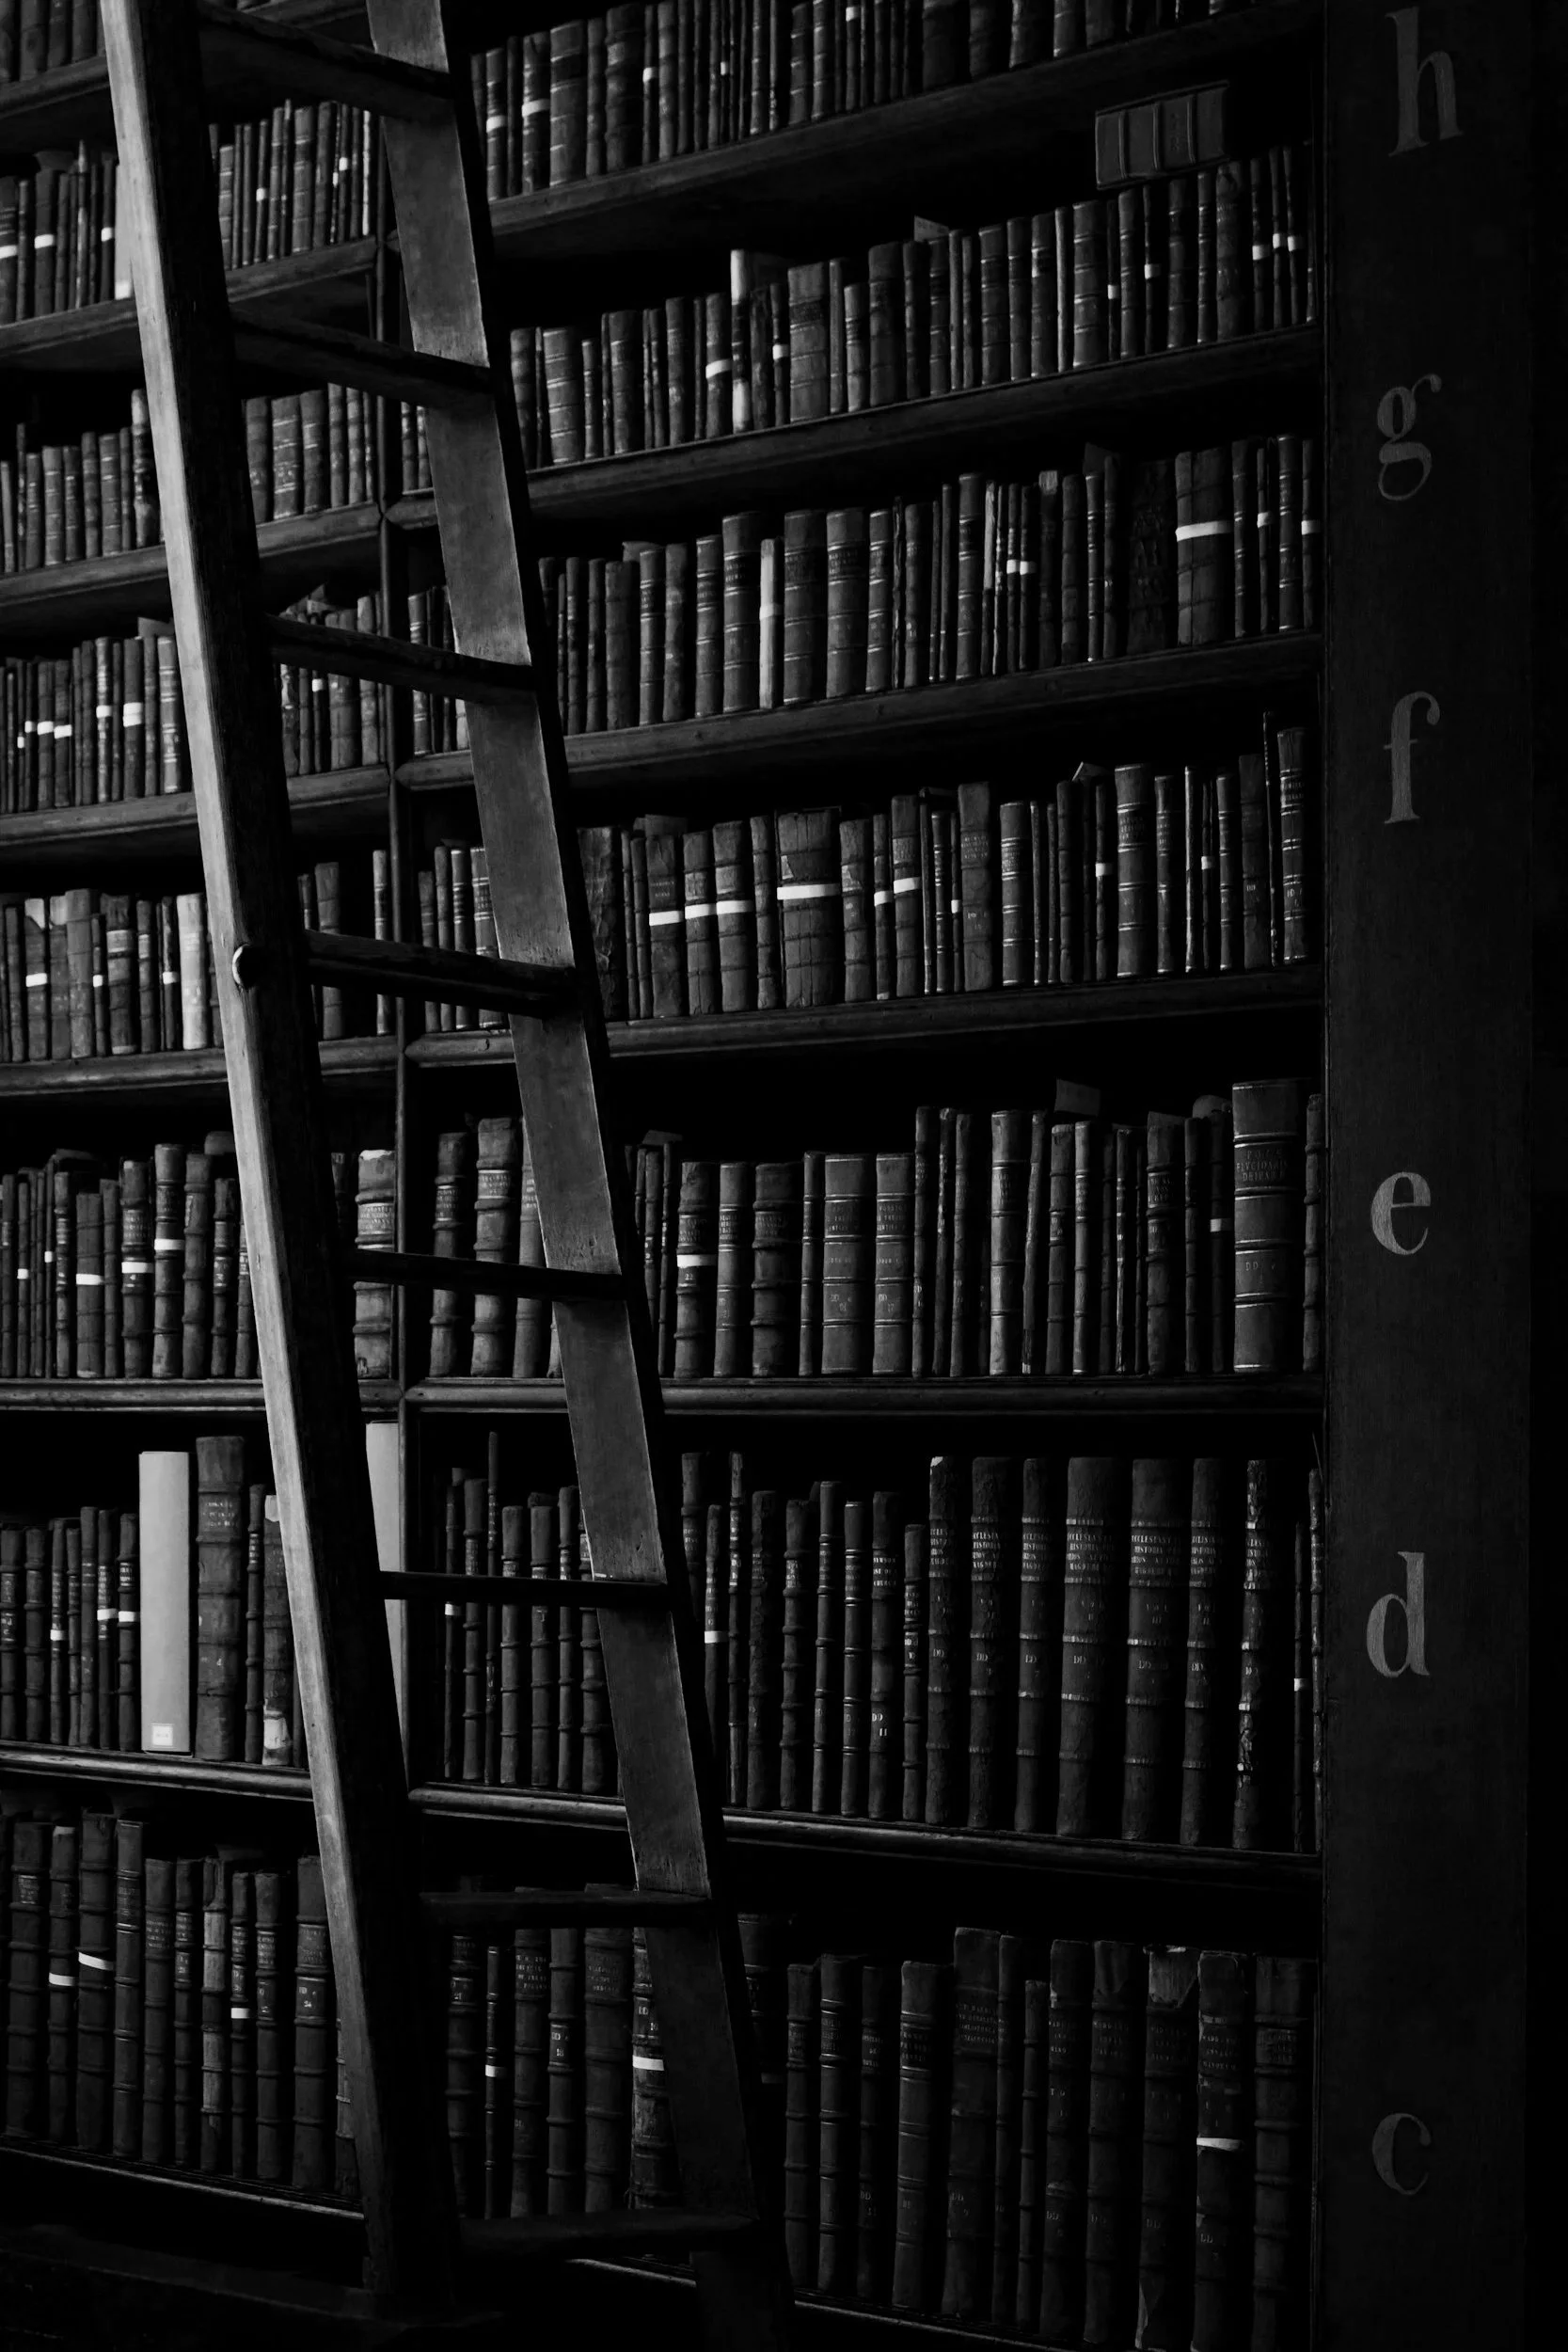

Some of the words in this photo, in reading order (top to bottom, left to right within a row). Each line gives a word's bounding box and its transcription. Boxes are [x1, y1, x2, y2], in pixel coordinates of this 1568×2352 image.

[1385, 6, 1464, 158] h
[1376, 373, 1443, 501] g
[1383, 691, 1441, 825] f
[1370, 1171, 1432, 1256] e
[1366, 1550, 1431, 1678] d
[1370, 2112, 1432, 2196] c
